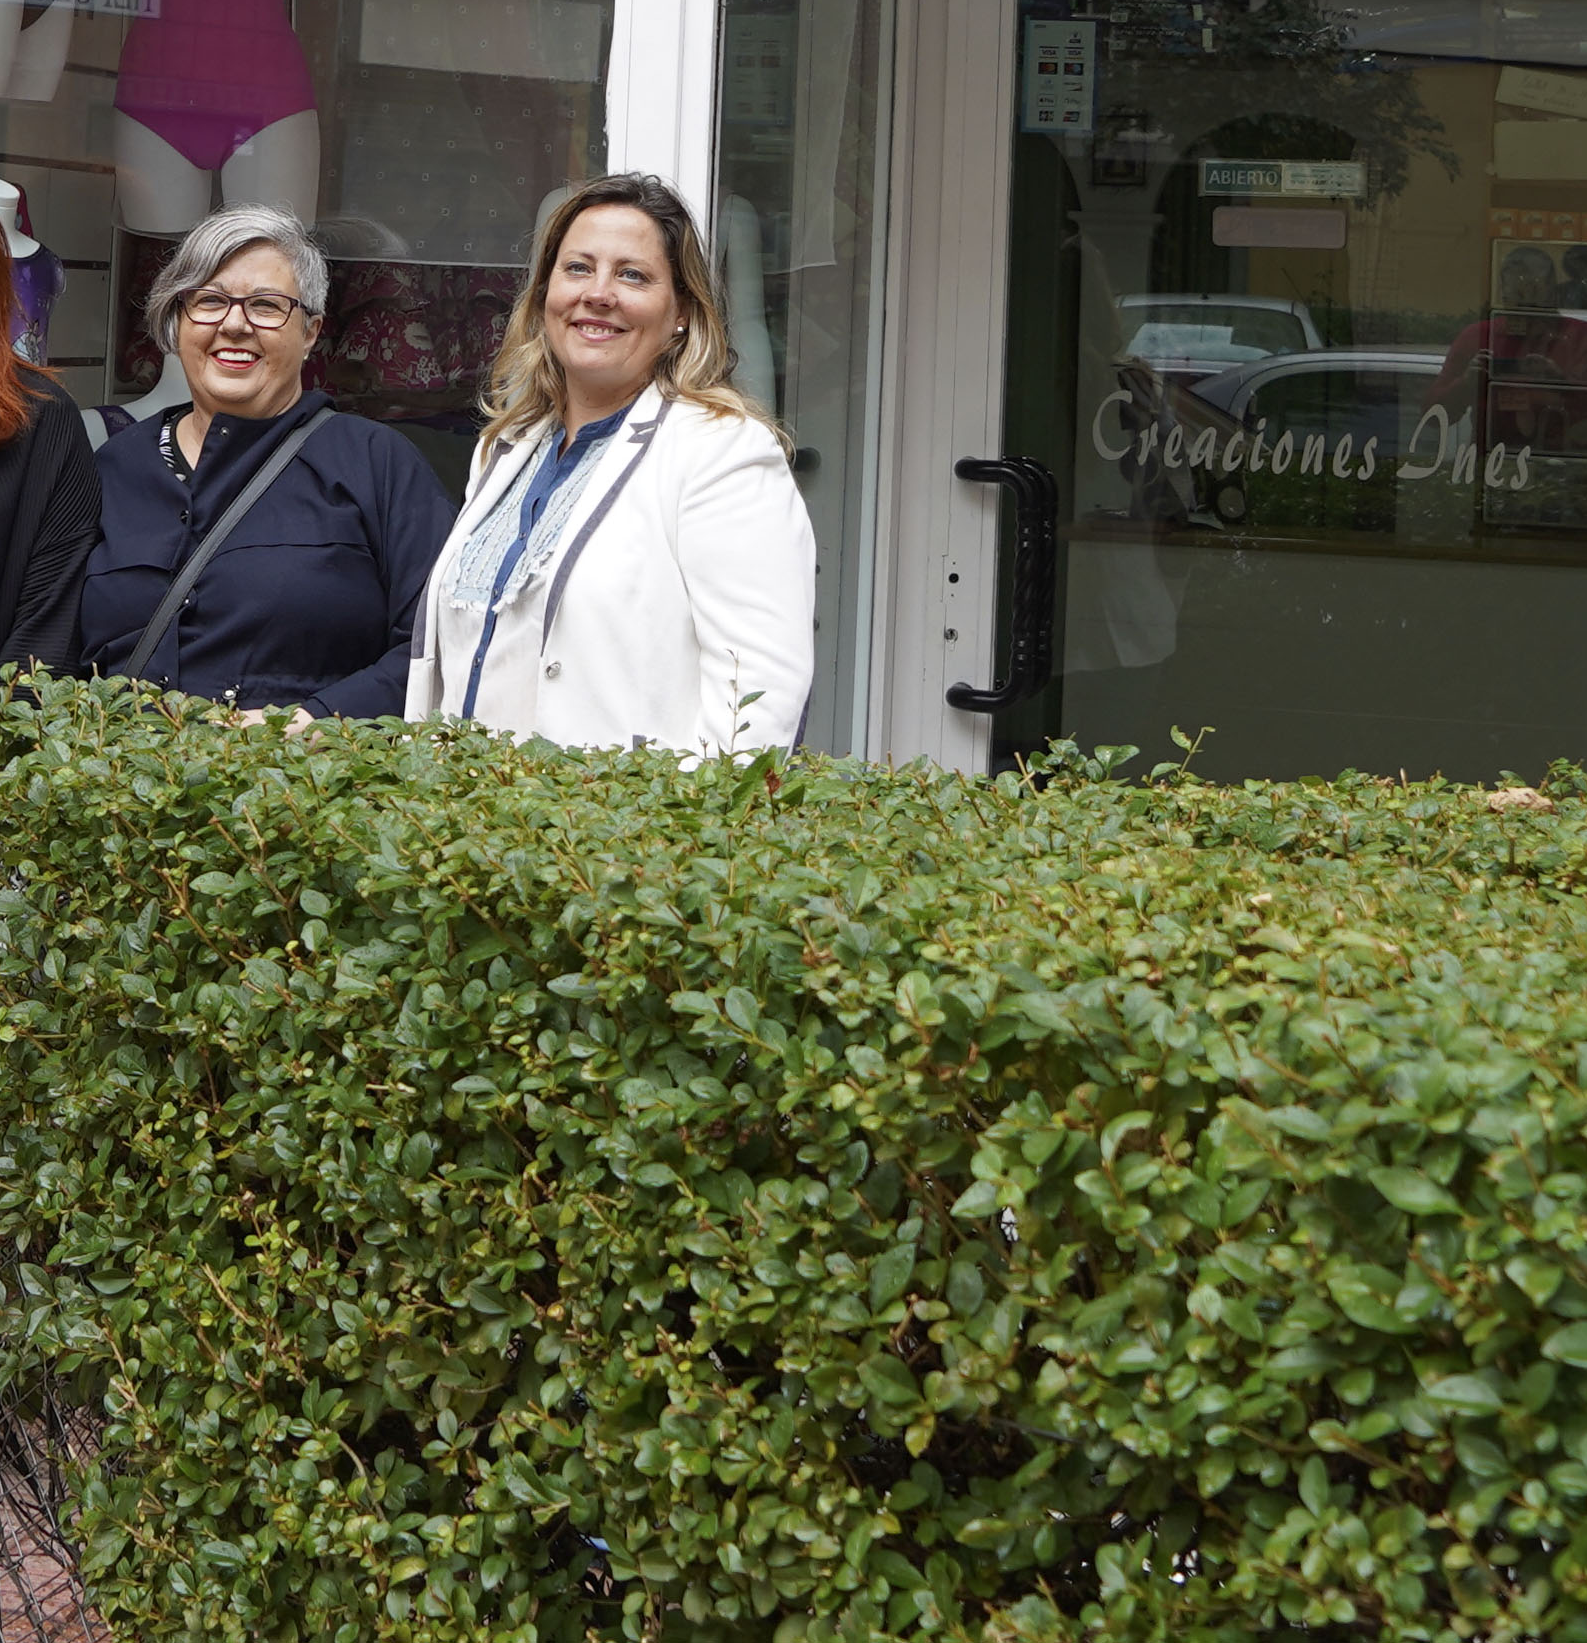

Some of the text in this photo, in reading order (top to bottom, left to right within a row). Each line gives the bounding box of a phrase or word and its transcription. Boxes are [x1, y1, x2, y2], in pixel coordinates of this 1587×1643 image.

[1208, 169, 1279, 186] ABIERTO
[1092, 390, 1533, 492] Creaciones Ines
